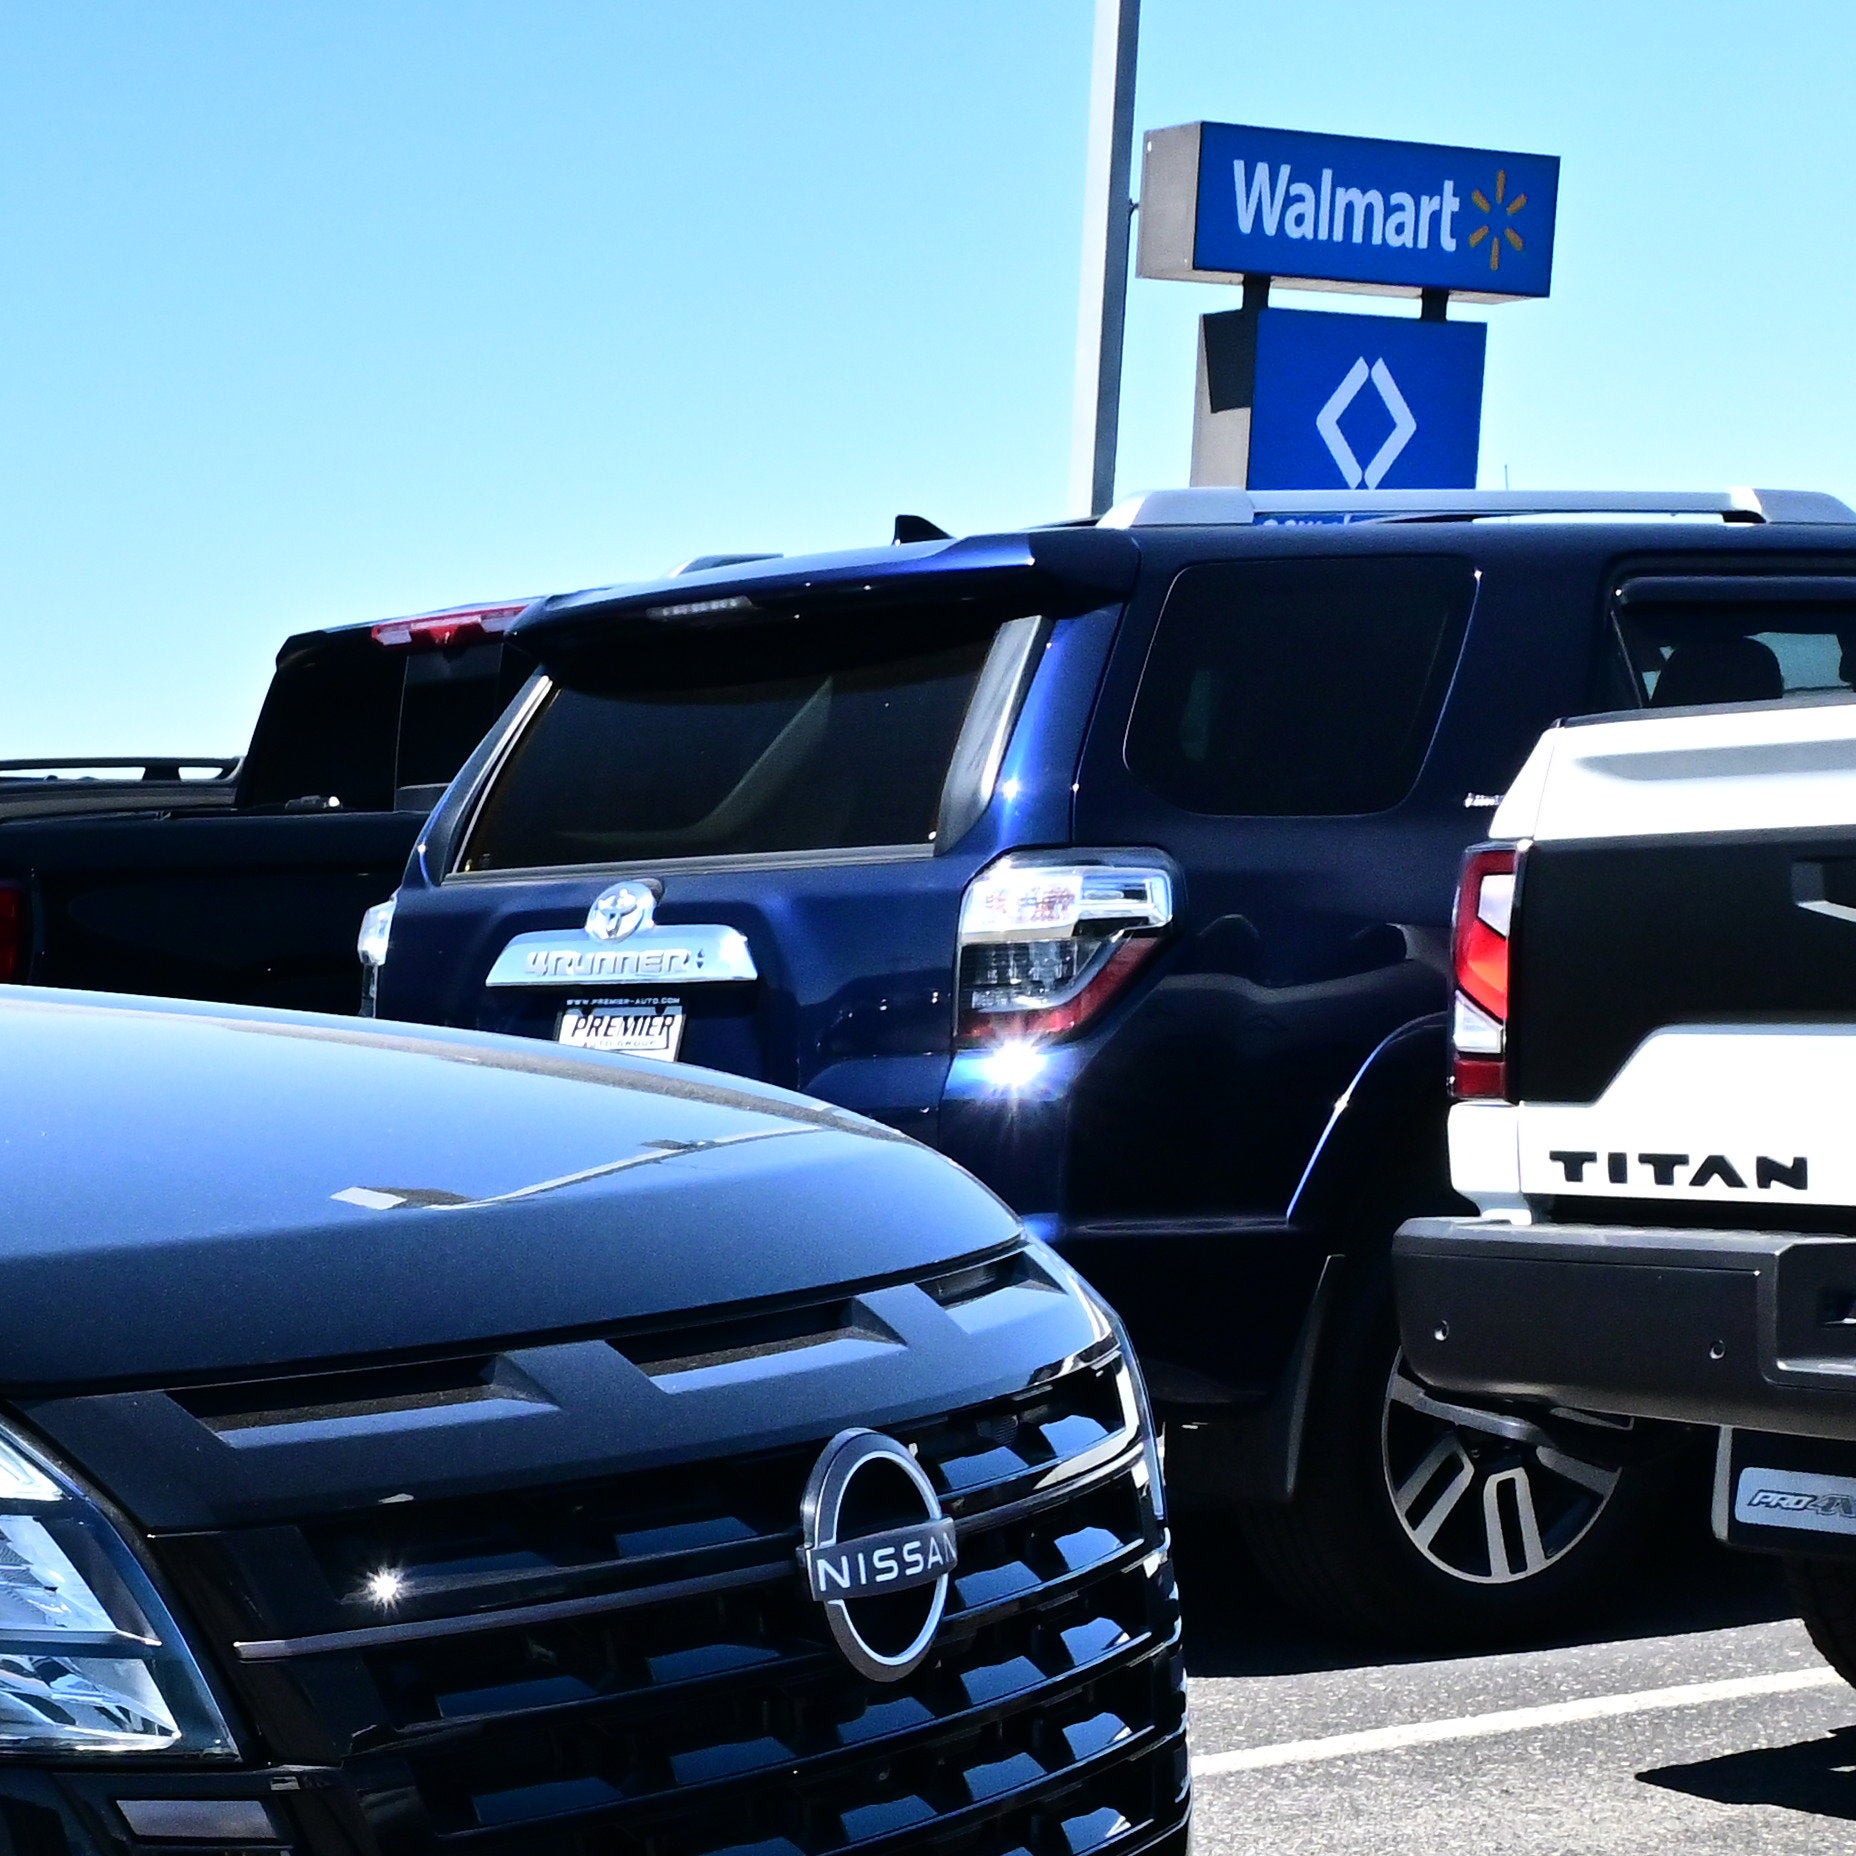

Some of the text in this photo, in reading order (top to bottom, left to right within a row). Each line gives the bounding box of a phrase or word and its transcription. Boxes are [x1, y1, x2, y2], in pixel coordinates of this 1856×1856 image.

[1233, 159, 1460, 251] Walmart
[526, 949, 692, 976] 4RUNNER
[571, 1014, 675, 1038] PREMIER
[1549, 1150, 1808, 1190] TITAN
[817, 1532, 957, 1592] NISSAN
